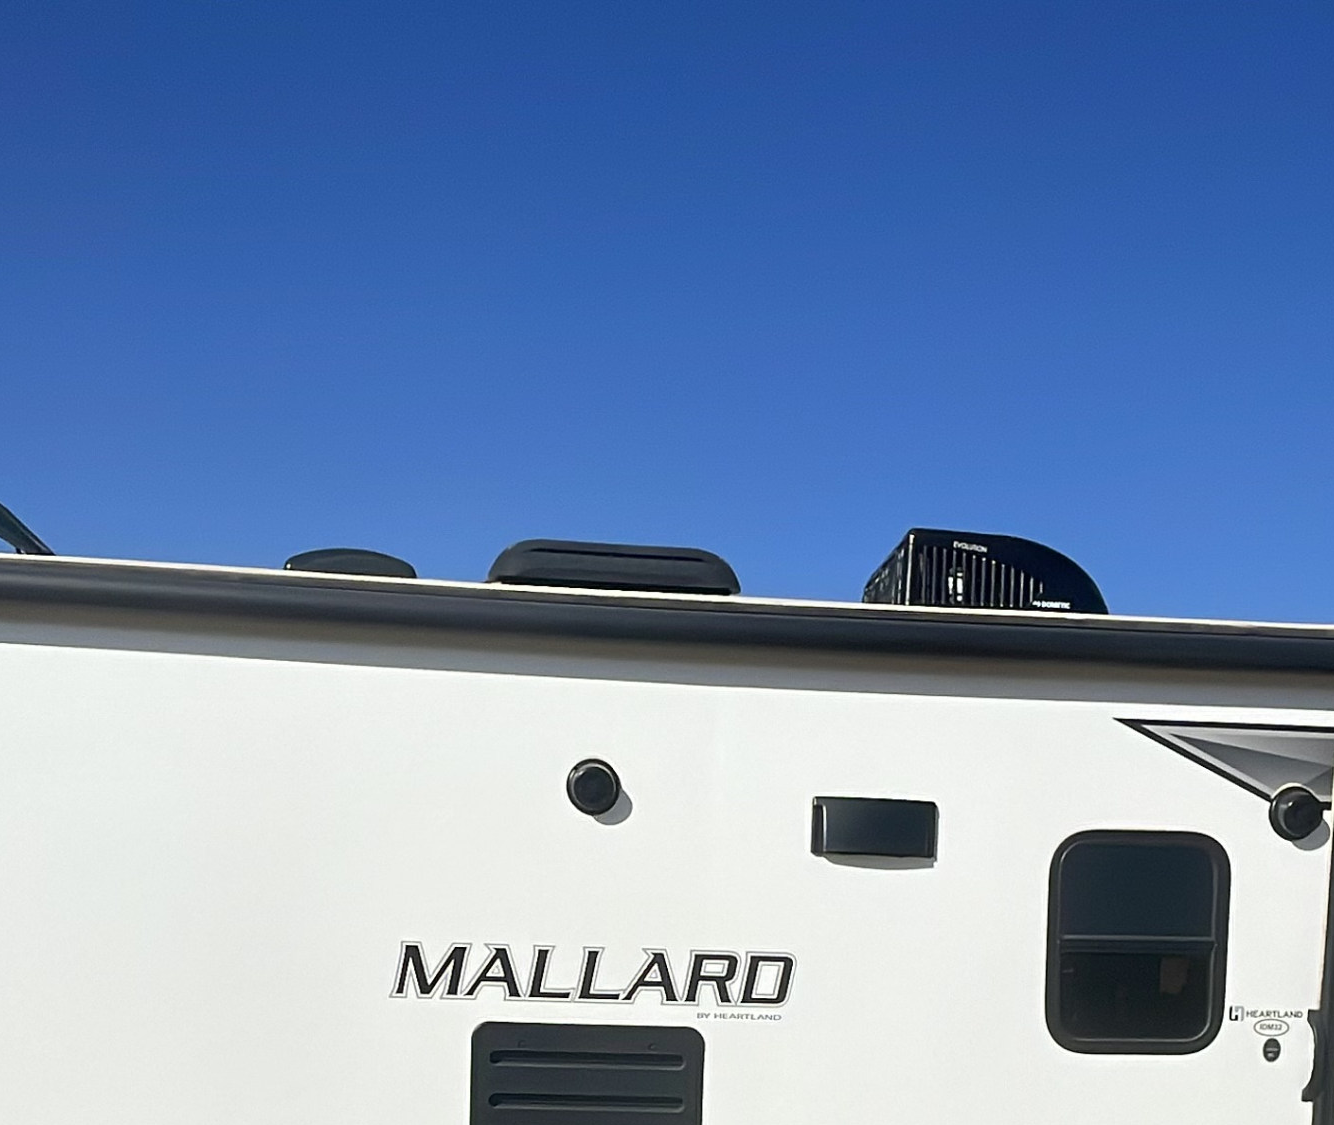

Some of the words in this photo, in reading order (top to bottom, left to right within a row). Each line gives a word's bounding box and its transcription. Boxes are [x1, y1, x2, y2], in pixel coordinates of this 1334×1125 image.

[389, 941, 797, 1008] MALLARD
[713, 1012, 783, 1021] HEARTLAND
[1246, 1009, 1303, 1019] HEARTLAND
